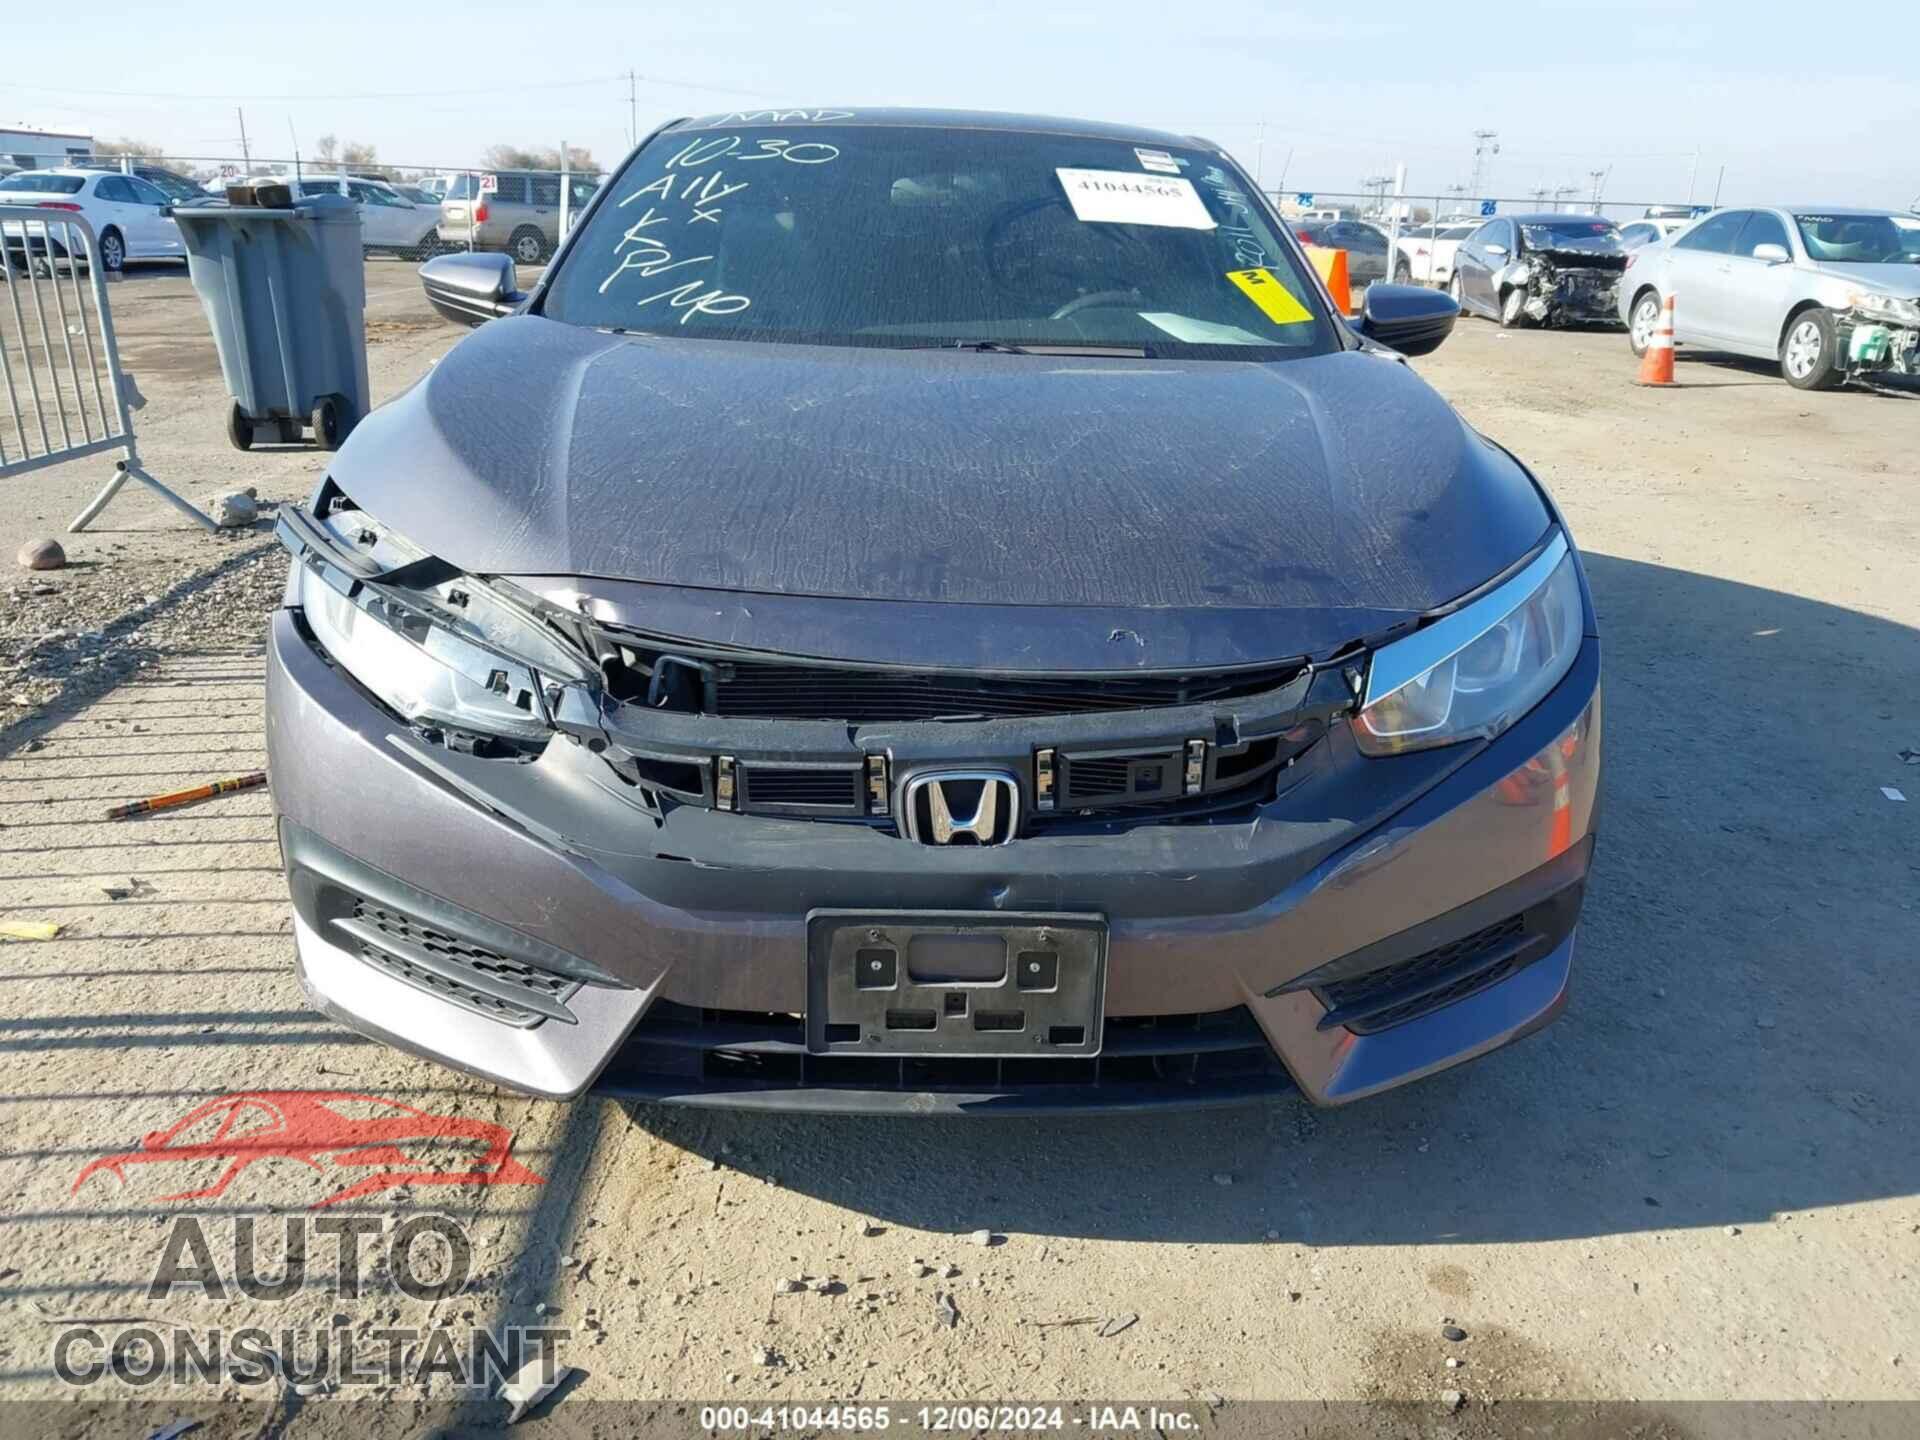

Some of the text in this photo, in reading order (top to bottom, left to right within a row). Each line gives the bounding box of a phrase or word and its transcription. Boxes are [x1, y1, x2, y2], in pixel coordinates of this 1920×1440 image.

[481, 176, 496, 189] 21
[1078, 181, 1183, 197] 41044565
[1480, 200, 1497, 216] 26
